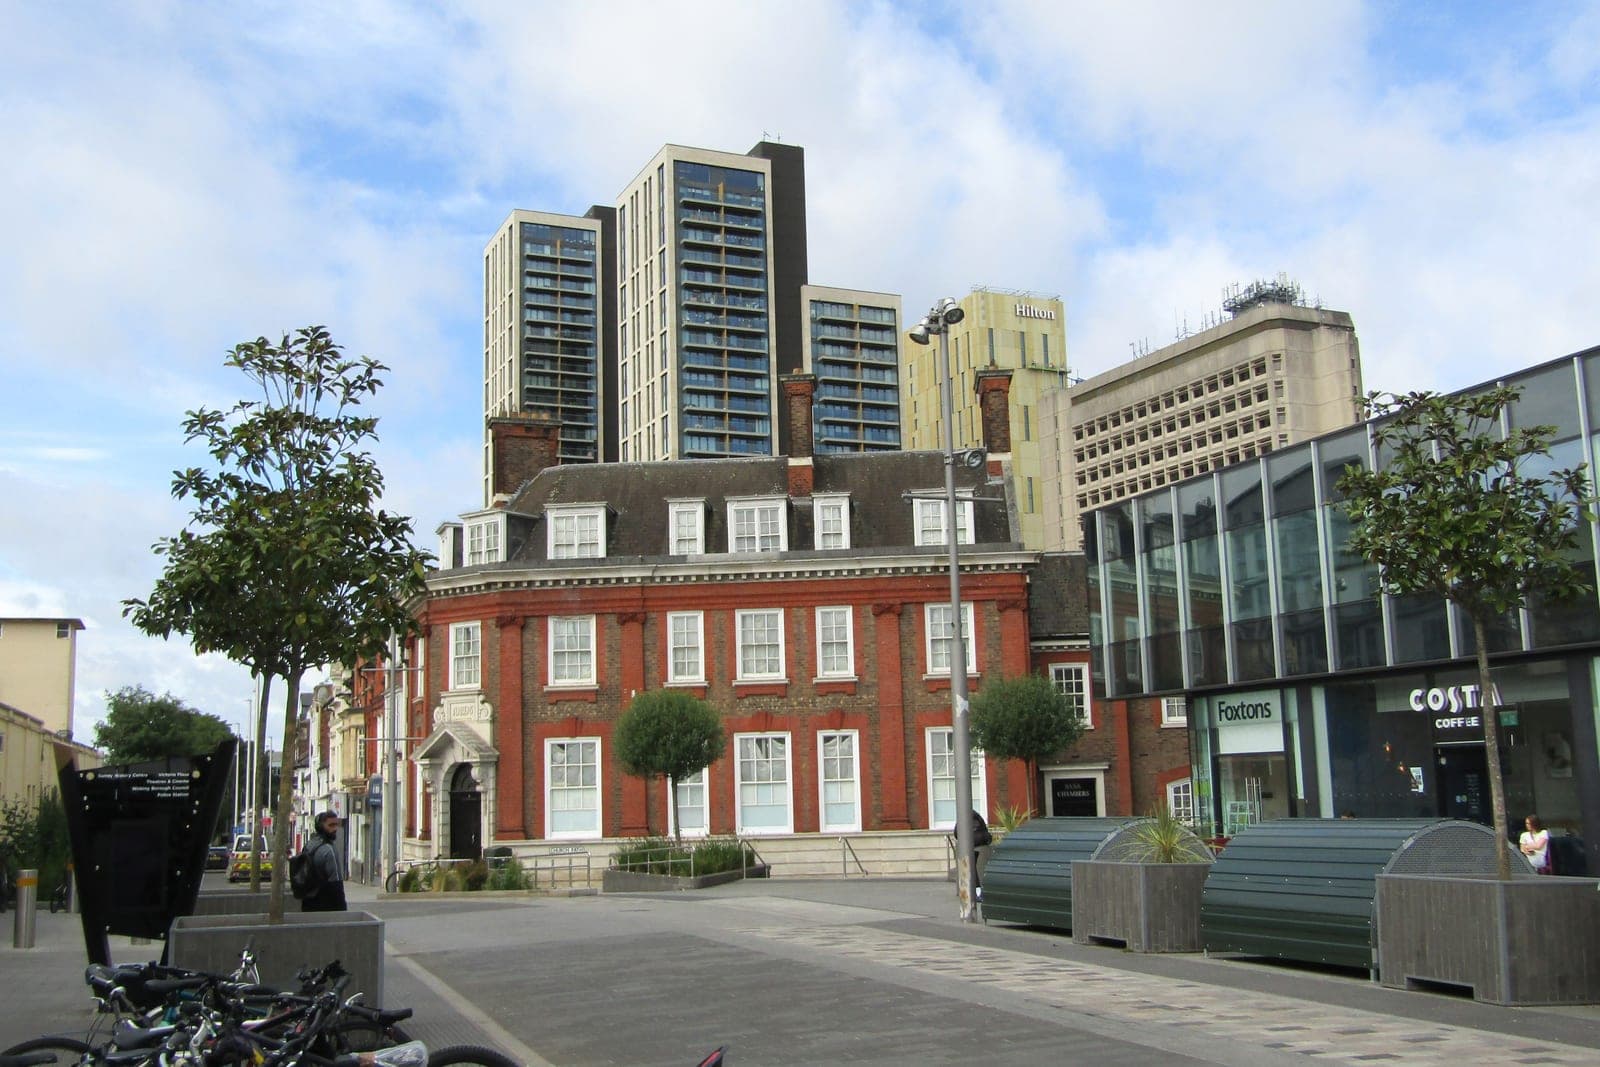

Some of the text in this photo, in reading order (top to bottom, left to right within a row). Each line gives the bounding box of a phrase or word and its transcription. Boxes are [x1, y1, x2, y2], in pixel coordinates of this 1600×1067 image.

[1015, 303, 1055, 320] Hilton
[1218, 701, 1272, 721] Foxtons
[1435, 716, 1480, 729] COFFEE
